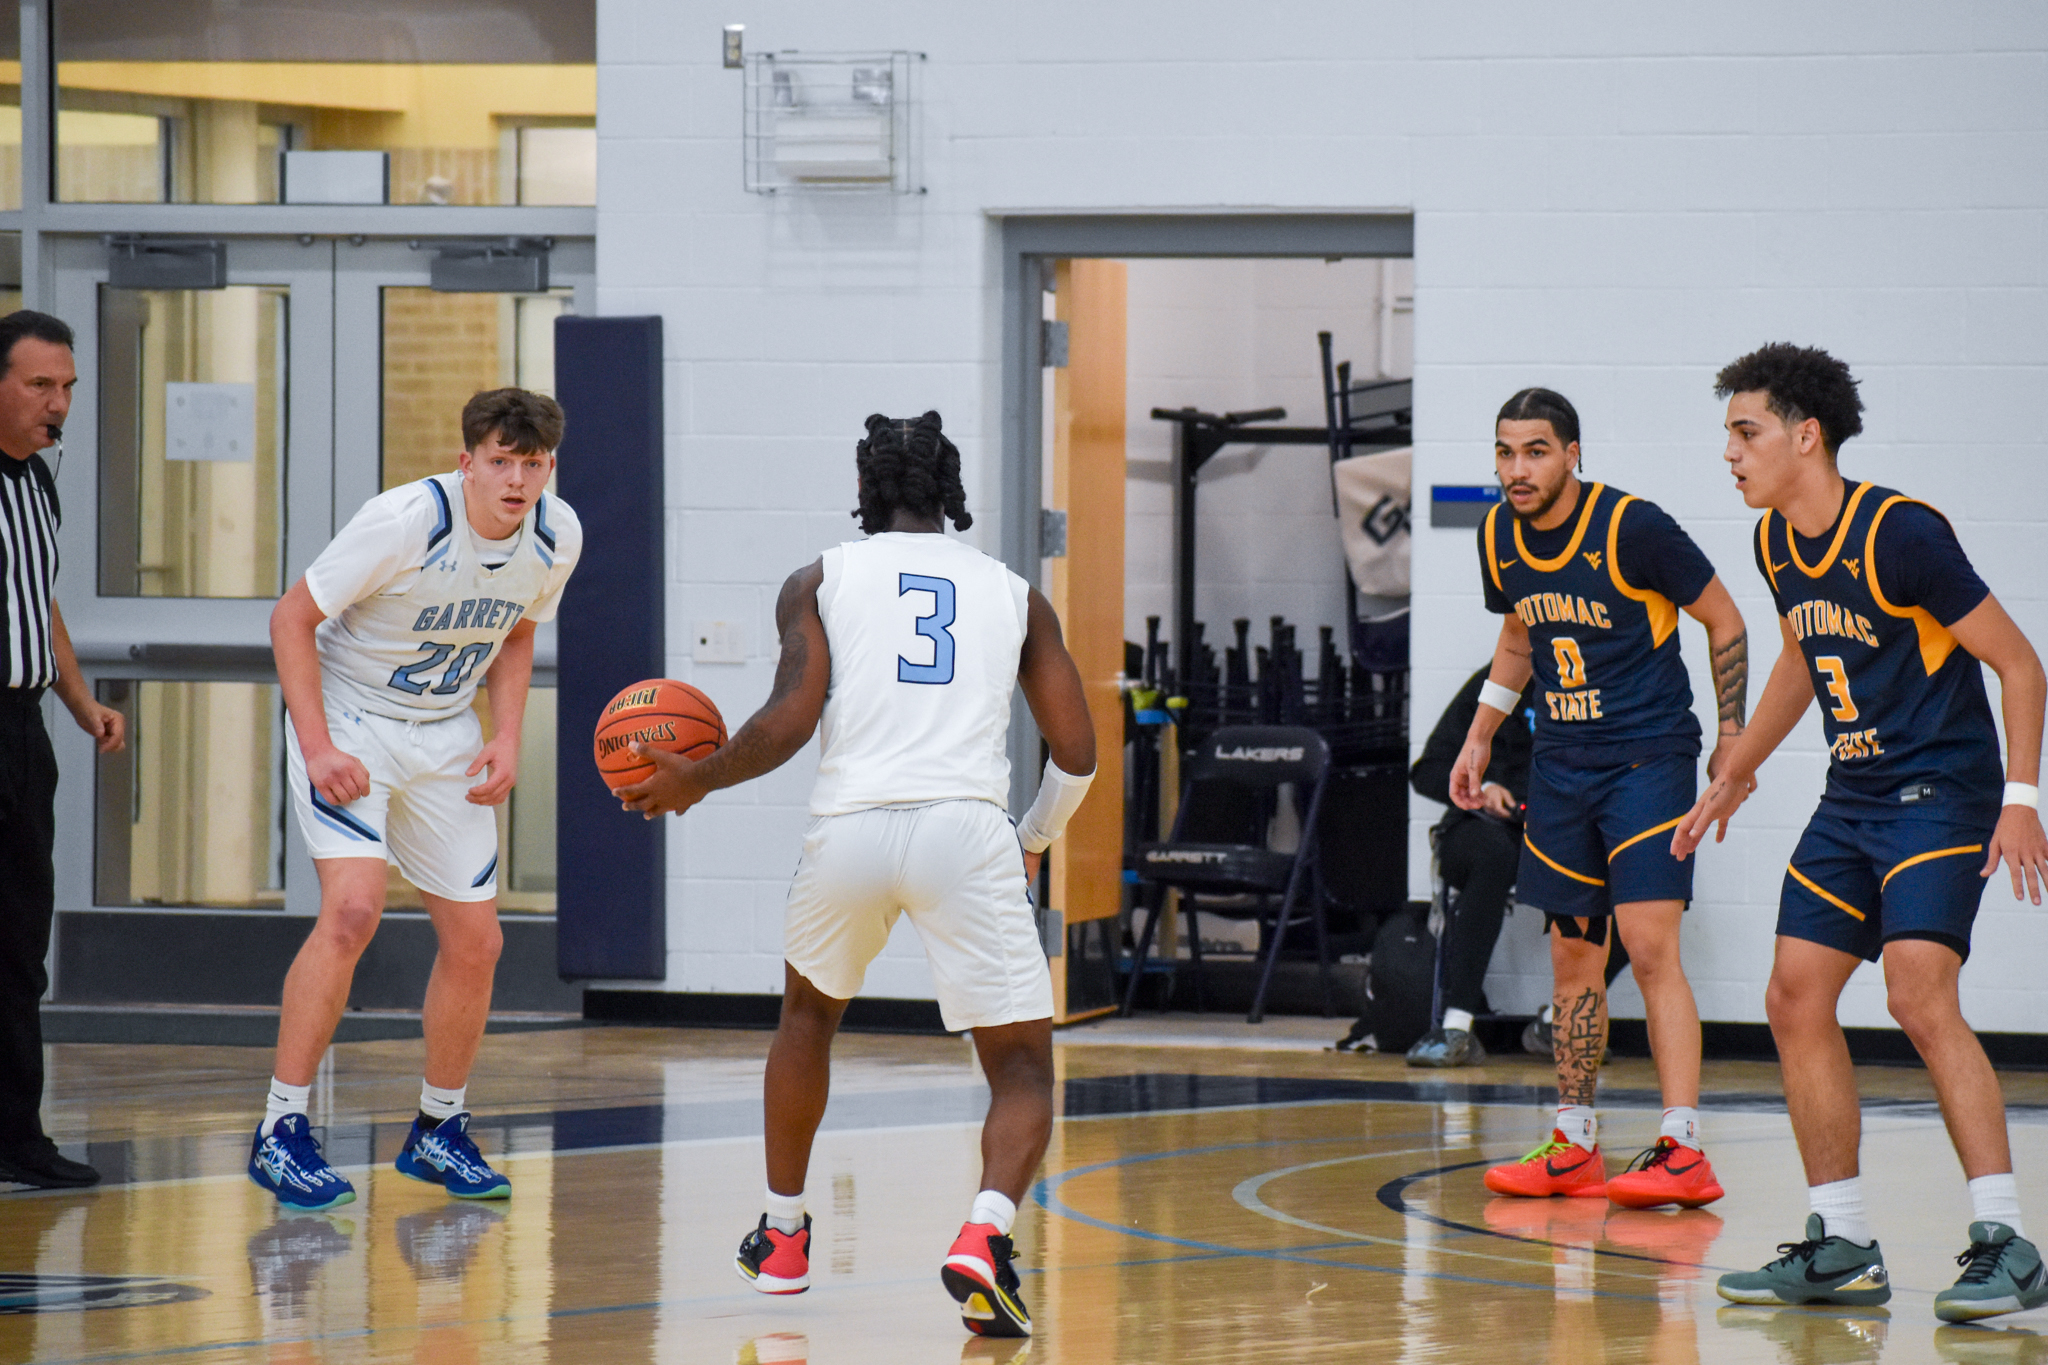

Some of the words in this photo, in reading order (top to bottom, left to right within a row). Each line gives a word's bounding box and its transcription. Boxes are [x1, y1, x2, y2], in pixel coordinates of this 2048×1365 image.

[412, 598, 525, 632] GARRETT
[897, 572, 956, 685] 3
[1787, 600, 1879, 648] OTOMAC
[387, 641, 493, 695] 20
[1550, 637, 1587, 688] 0
[1545, 689, 1603, 721] STATE
[1815, 655, 1859, 723] 3
[599, 721, 677, 759] SPALDING
[1215, 745, 1304, 762] LAKERS
